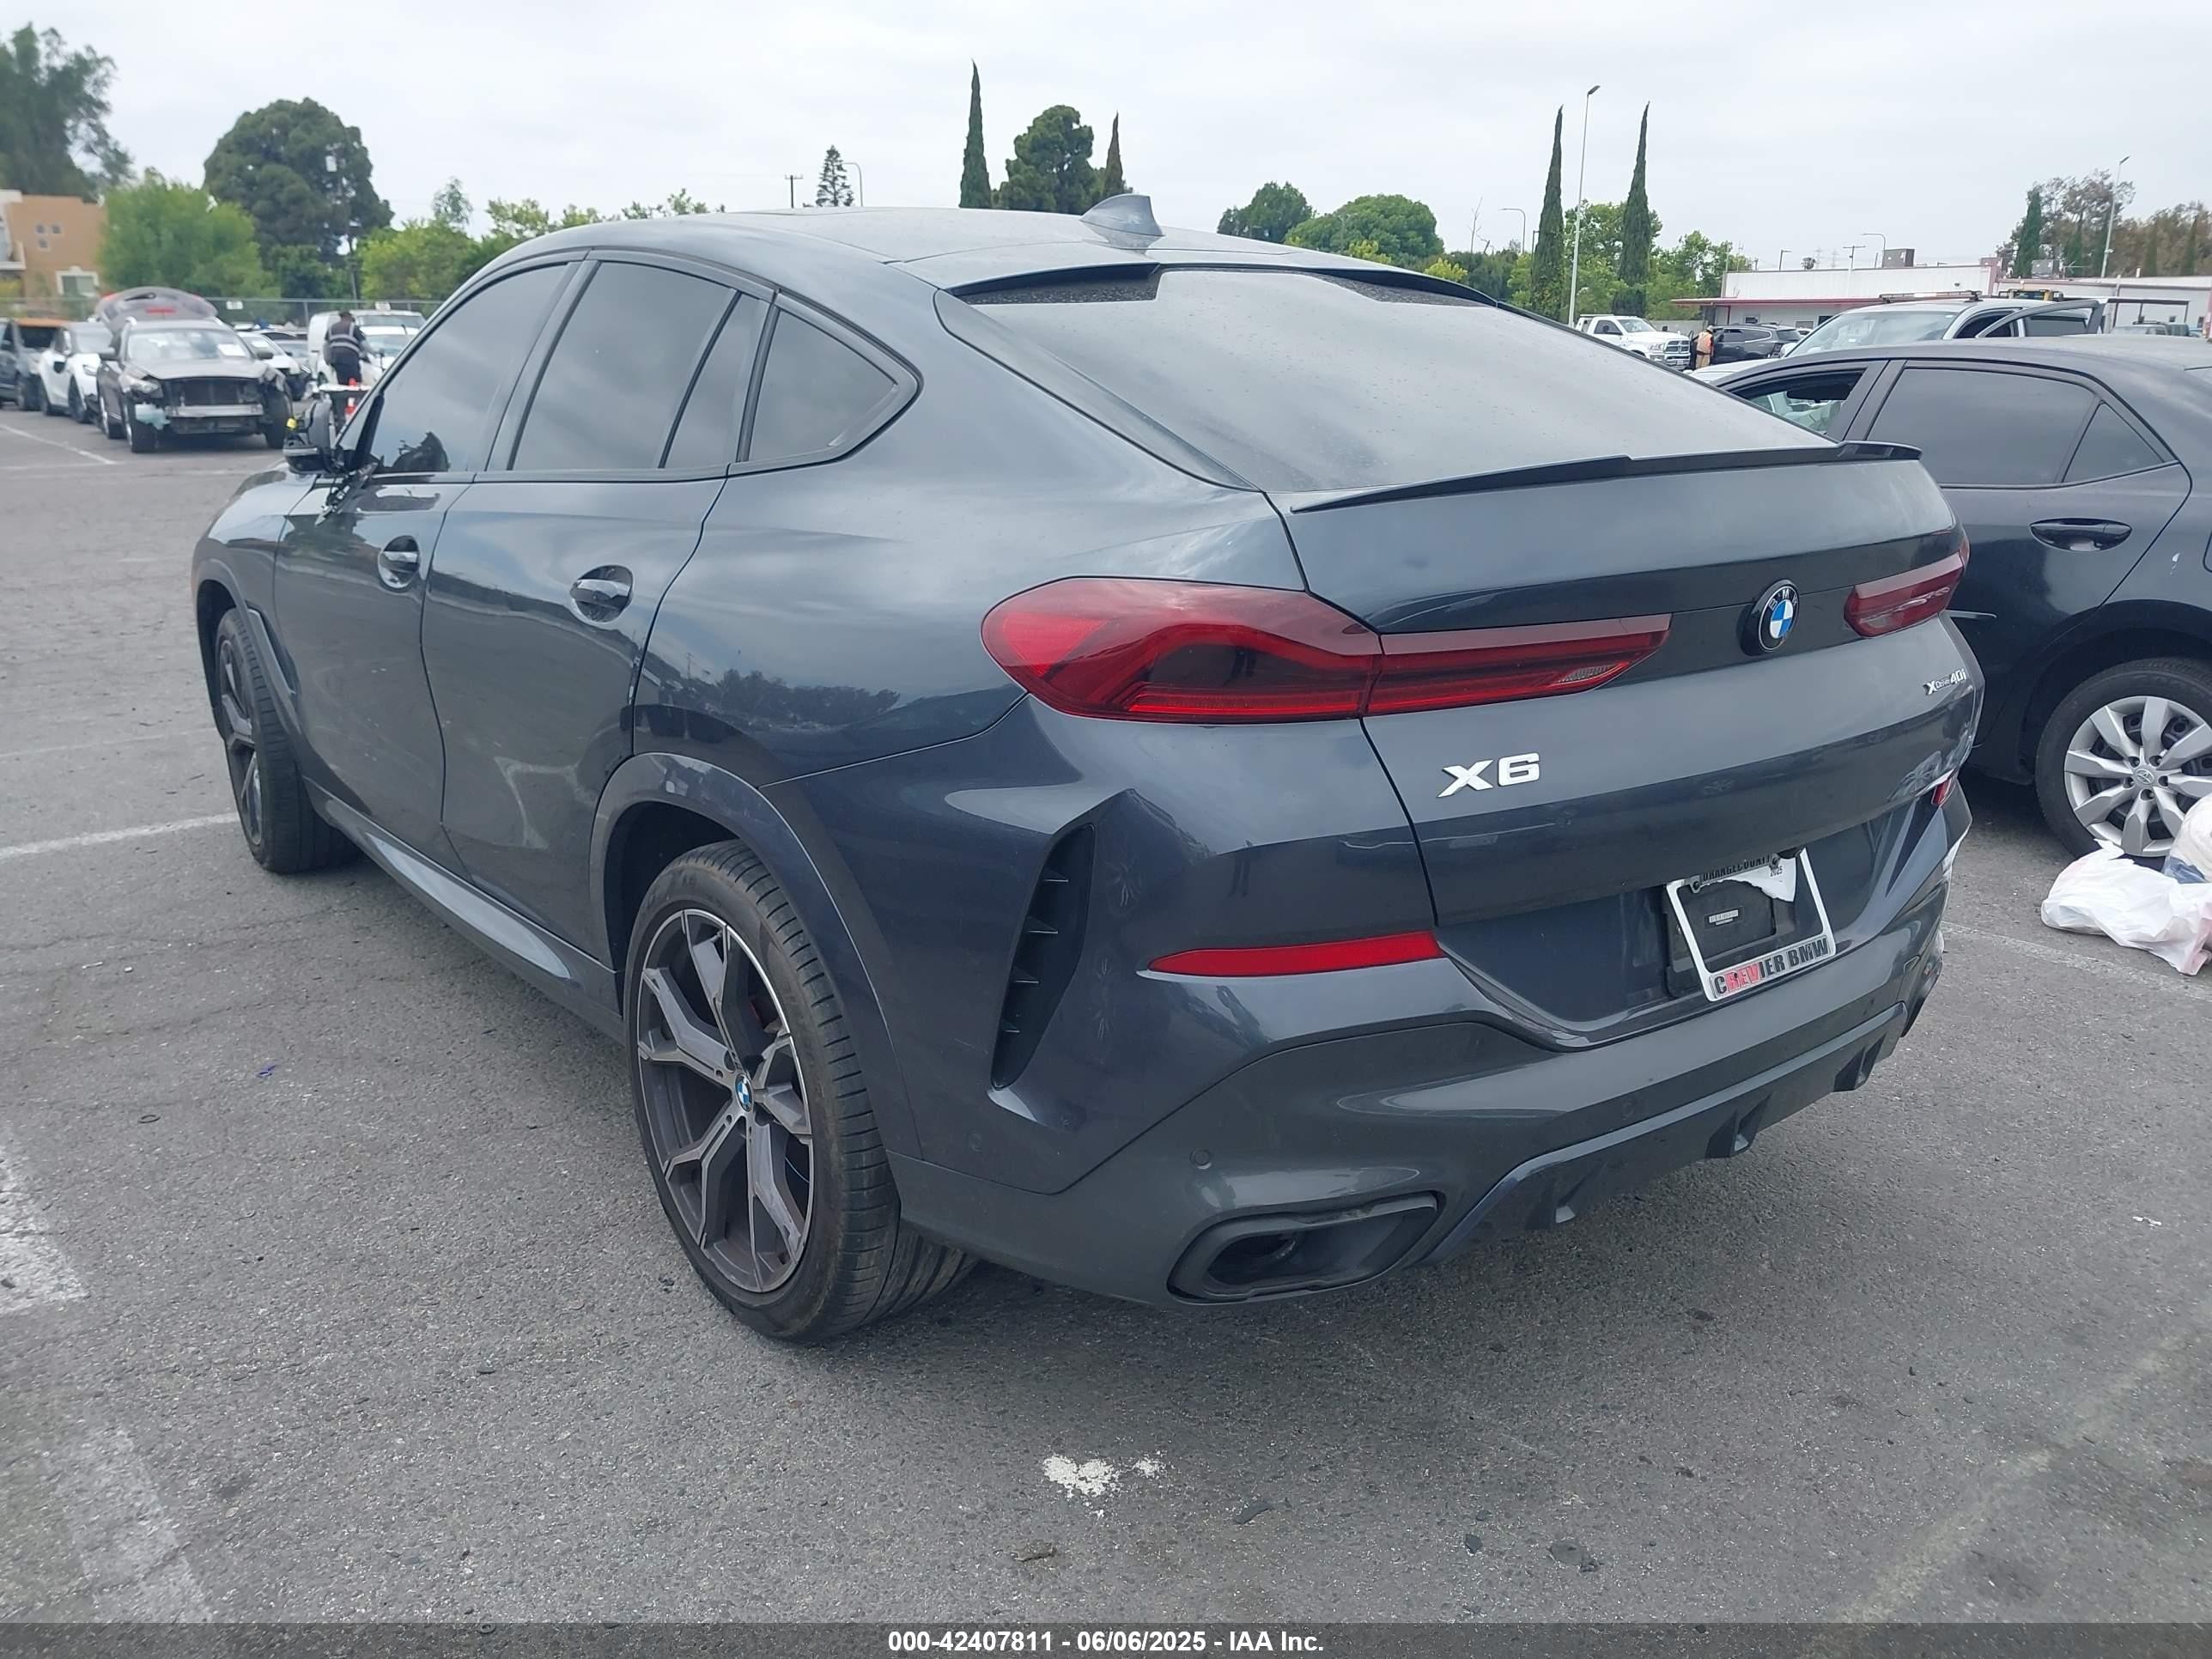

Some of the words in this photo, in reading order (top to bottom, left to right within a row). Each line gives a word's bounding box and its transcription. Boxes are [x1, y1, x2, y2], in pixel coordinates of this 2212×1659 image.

[1769, 588, 1797, 611] BMW
[1437, 752, 1540, 798] X6
[1714, 954, 1786, 994] CREVIER
[1787, 938, 1829, 968] BMW
